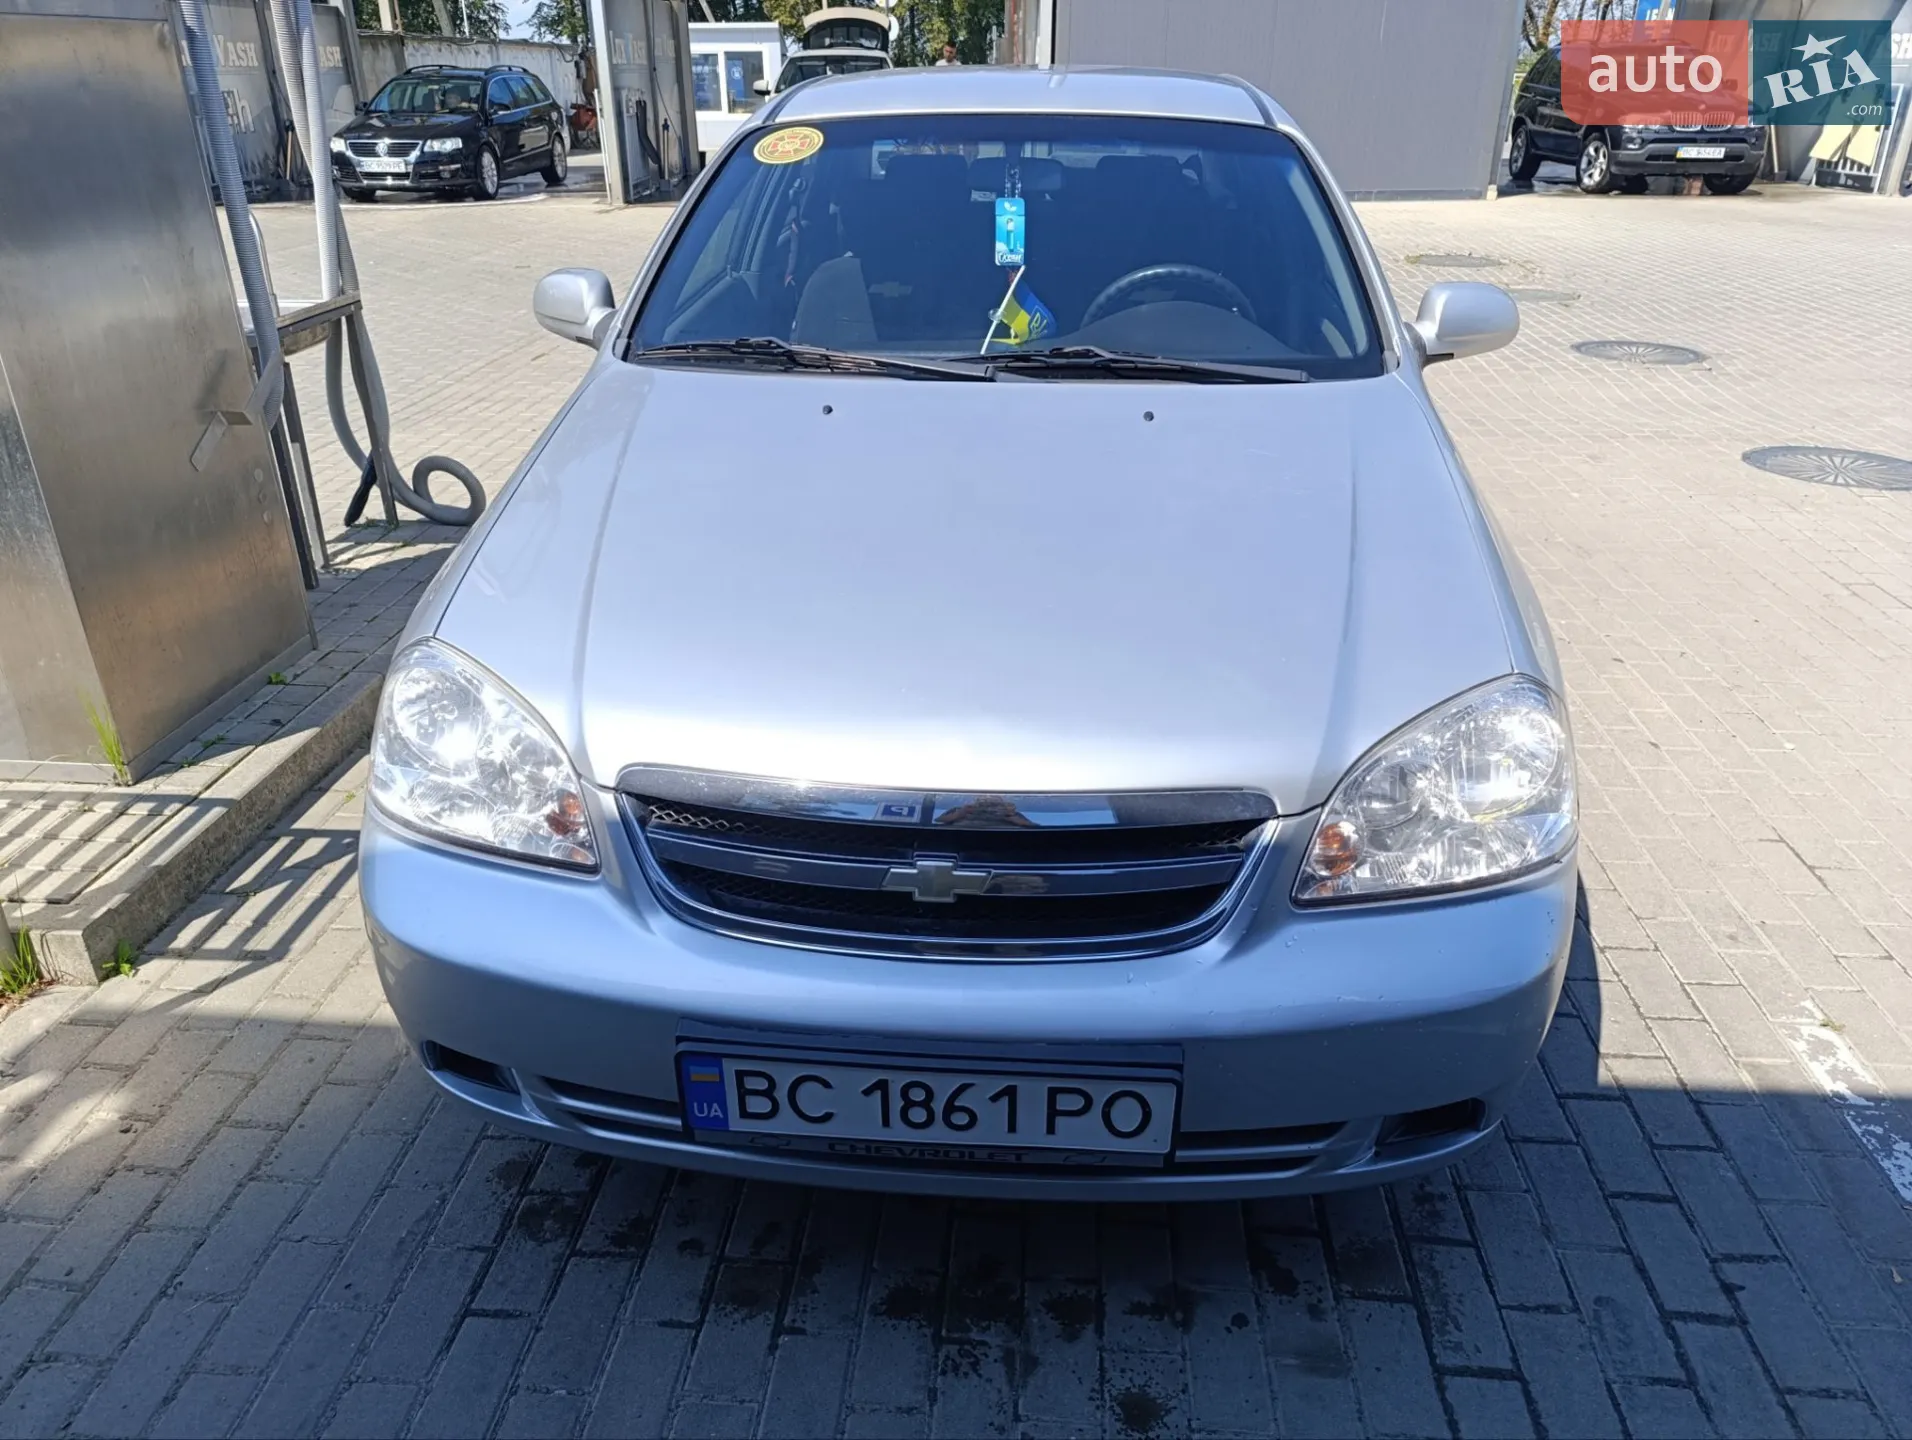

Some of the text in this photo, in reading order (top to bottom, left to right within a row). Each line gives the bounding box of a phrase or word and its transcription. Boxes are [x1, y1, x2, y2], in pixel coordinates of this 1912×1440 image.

[693, 1068, 1152, 1139] UA BC 1861 PO
[828, 1142, 1030, 1162] CHEVROLET
